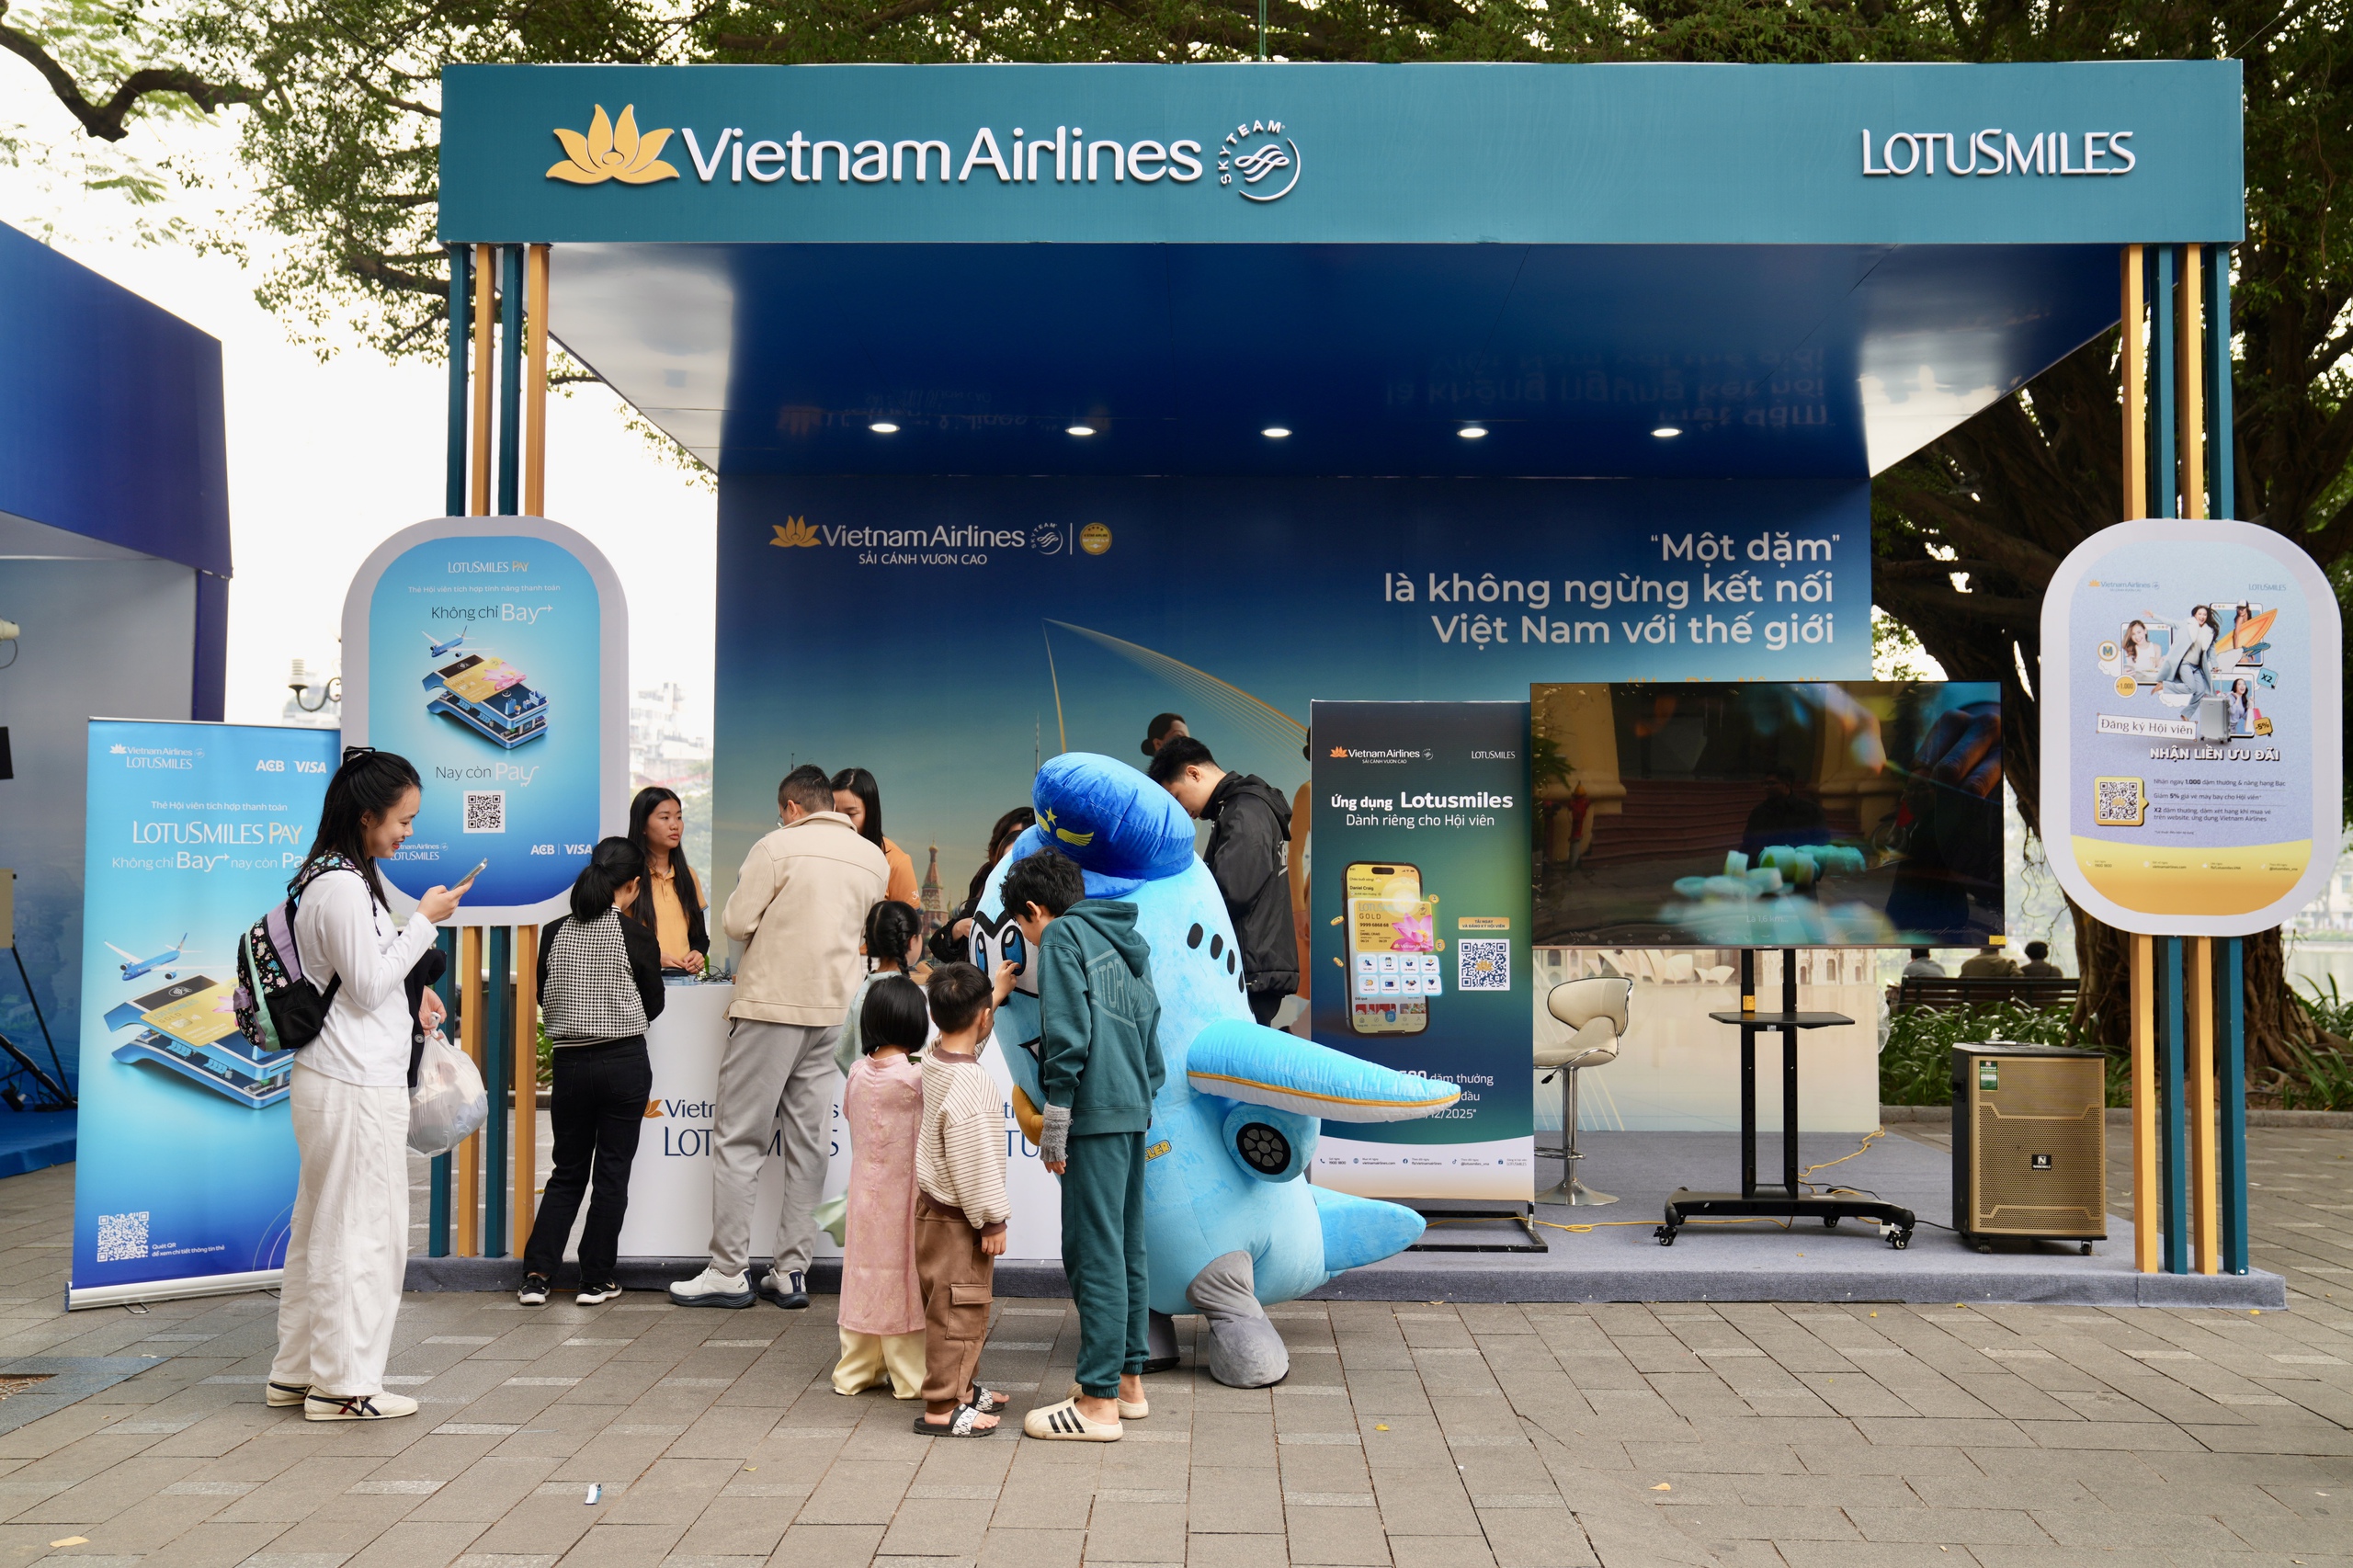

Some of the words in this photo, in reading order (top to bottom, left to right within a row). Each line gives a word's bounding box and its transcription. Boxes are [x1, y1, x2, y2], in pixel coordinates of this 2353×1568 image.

[682, 127, 956, 183] Vietnam
[959, 125, 1203, 183] Airlines
[1218, 119, 1281, 186] SKYTEAM
[1862, 128, 2136, 176] LOTUSMILES
[823, 525, 928, 548] Vietnam
[930, 524, 1025, 548] Airlines
[1030, 522, 1056, 549] SKYTEAM
[858, 551, 877, 564] SẢI
[881, 551, 917, 564] CÁNH
[920, 551, 949, 564] VƯƠN
[961, 554, 987, 564] CAO
[1651, 532, 1736, 568] “Một
[1747, 531, 1840, 568] dặm”
[448, 562, 509, 573] LOTUSMILES
[512, 561, 529, 573] PAY
[1385, 574, 1415, 603] là
[1429, 574, 1551, 609] không
[1565, 574, 1689, 609] ngừng
[1703, 570, 1763, 603] kết
[1776, 570, 1833, 603] nối
[431, 606, 476, 621] Không
[478, 606, 499, 619] chỉ
[501, 603, 544, 625] Bay
[1431, 615, 1507, 650] Việt
[1522, 615, 1610, 643] Nam
[1622, 614, 1676, 643] với
[1688, 611, 1754, 643] thế
[1764, 614, 1834, 651] giới
[2103, 646, 2112, 655] M
[2261, 672, 2273, 683] X2
[2101, 719, 2130, 733] Đăng
[2132, 720, 2145, 733] ký
[2149, 722, 2167, 735] Hội
[2171, 724, 2193, 735] viên
[127, 746, 162, 756] Vietnam
[162, 747, 192, 756] Airlines
[1347, 749, 1386, 758] Vietnam
[1387, 749, 1420, 758] Airlines
[1472, 750, 1516, 759] LOTUSMILES
[2150, 744, 2190, 763] NHẬN
[2194, 744, 2223, 760] LIỀN
[2228, 748, 2251, 761] ƯU
[2255, 745, 2280, 762] ĐÃI
[126, 756, 192, 769] LOTUSMILES
[256, 759, 285, 772] ACB
[293, 760, 326, 773] VISA
[436, 766, 463, 781] Nay
[466, 766, 492, 778] còn
[495, 762, 540, 787] Pay
[151, 801, 167, 810] Thẻ
[169, 801, 184, 811] Hội
[186, 801, 205, 810] viên
[206, 801, 222, 810] tích
[224, 802, 241, 812] hợp
[243, 802, 267, 811] thanh
[268, 803, 288, 812] toán
[1331, 793, 1357, 811] Ứng
[1360, 796, 1392, 811] dụng
[1401, 791, 1513, 809] Lotusmiles
[1347, 813, 1379, 826] Dành
[1382, 814, 1415, 829] riêng
[1418, 814, 1440, 826] cho
[1445, 813, 1465, 829] Hội
[1469, 814, 1495, 826] viên
[133, 821, 264, 845] LOTUSMILES
[268, 822, 302, 845] PAY
[530, 845, 554, 855] ACB
[563, 845, 593, 855] VISA
[112, 857, 153, 870] Không
[155, 857, 174, 869] chỉ
[176, 851, 219, 872] Bay
[231, 859, 252, 870] nay
[255, 858, 278, 869] còn
[282, 852, 308, 869] Pa
[1746, 915, 1756, 923] Là
[1758, 915, 1768, 924] 1,6
[1456, 1074, 1494, 1086] thưởng
[1461, 1090, 1480, 1101] đầu
[665, 1099, 716, 1118] Viet
